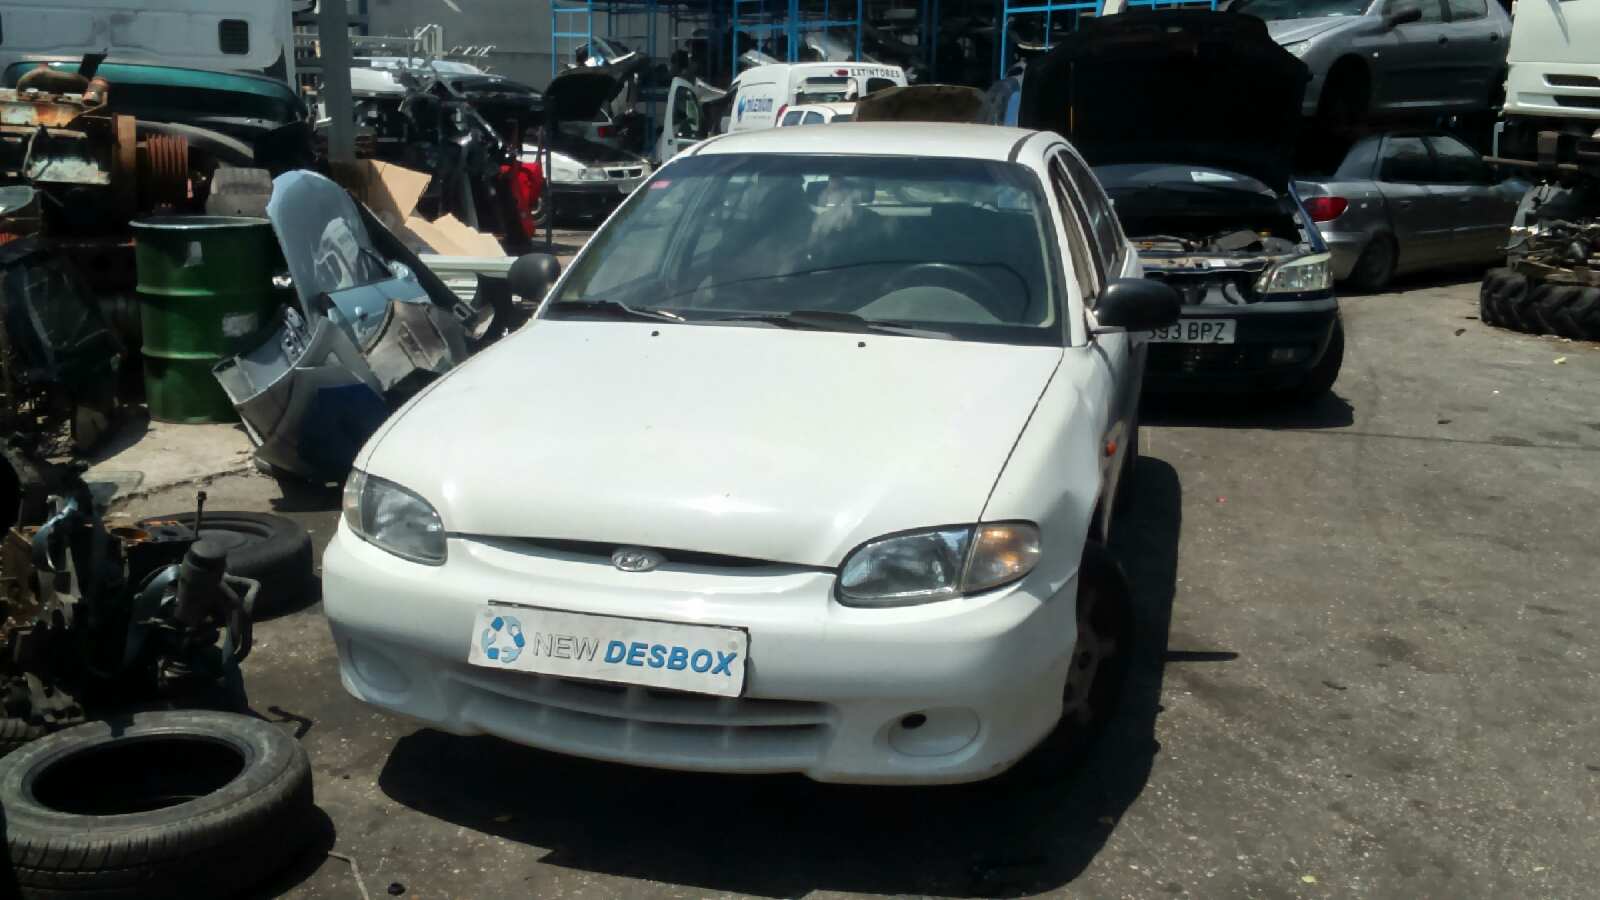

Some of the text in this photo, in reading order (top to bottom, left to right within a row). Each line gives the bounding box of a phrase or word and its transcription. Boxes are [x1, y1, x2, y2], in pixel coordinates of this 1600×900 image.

[850, 68, 900, 78] EXTINTORES
[1188, 322, 1226, 341] BPZ
[534, 632, 737, 676] NEW DESBOX
